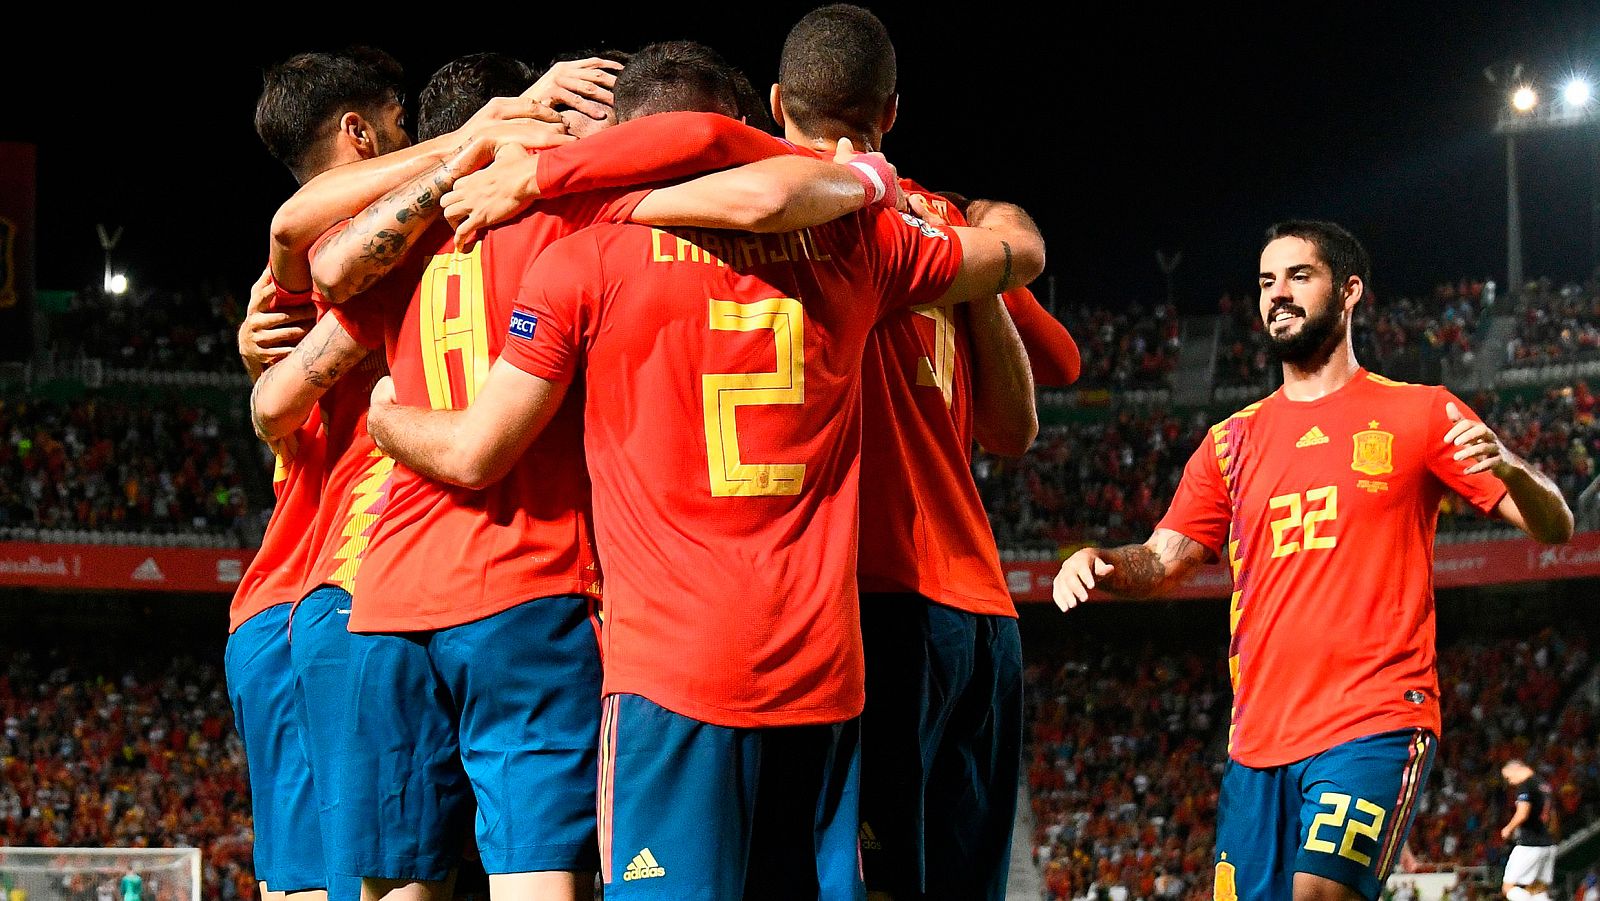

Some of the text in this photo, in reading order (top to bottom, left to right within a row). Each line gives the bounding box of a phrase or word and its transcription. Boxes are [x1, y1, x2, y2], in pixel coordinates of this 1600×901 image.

[702, 297, 807, 497] 2
[1269, 485, 1338, 559] 22
[1303, 792, 1387, 868] 22
[623, 866, 666, 882] adidas
